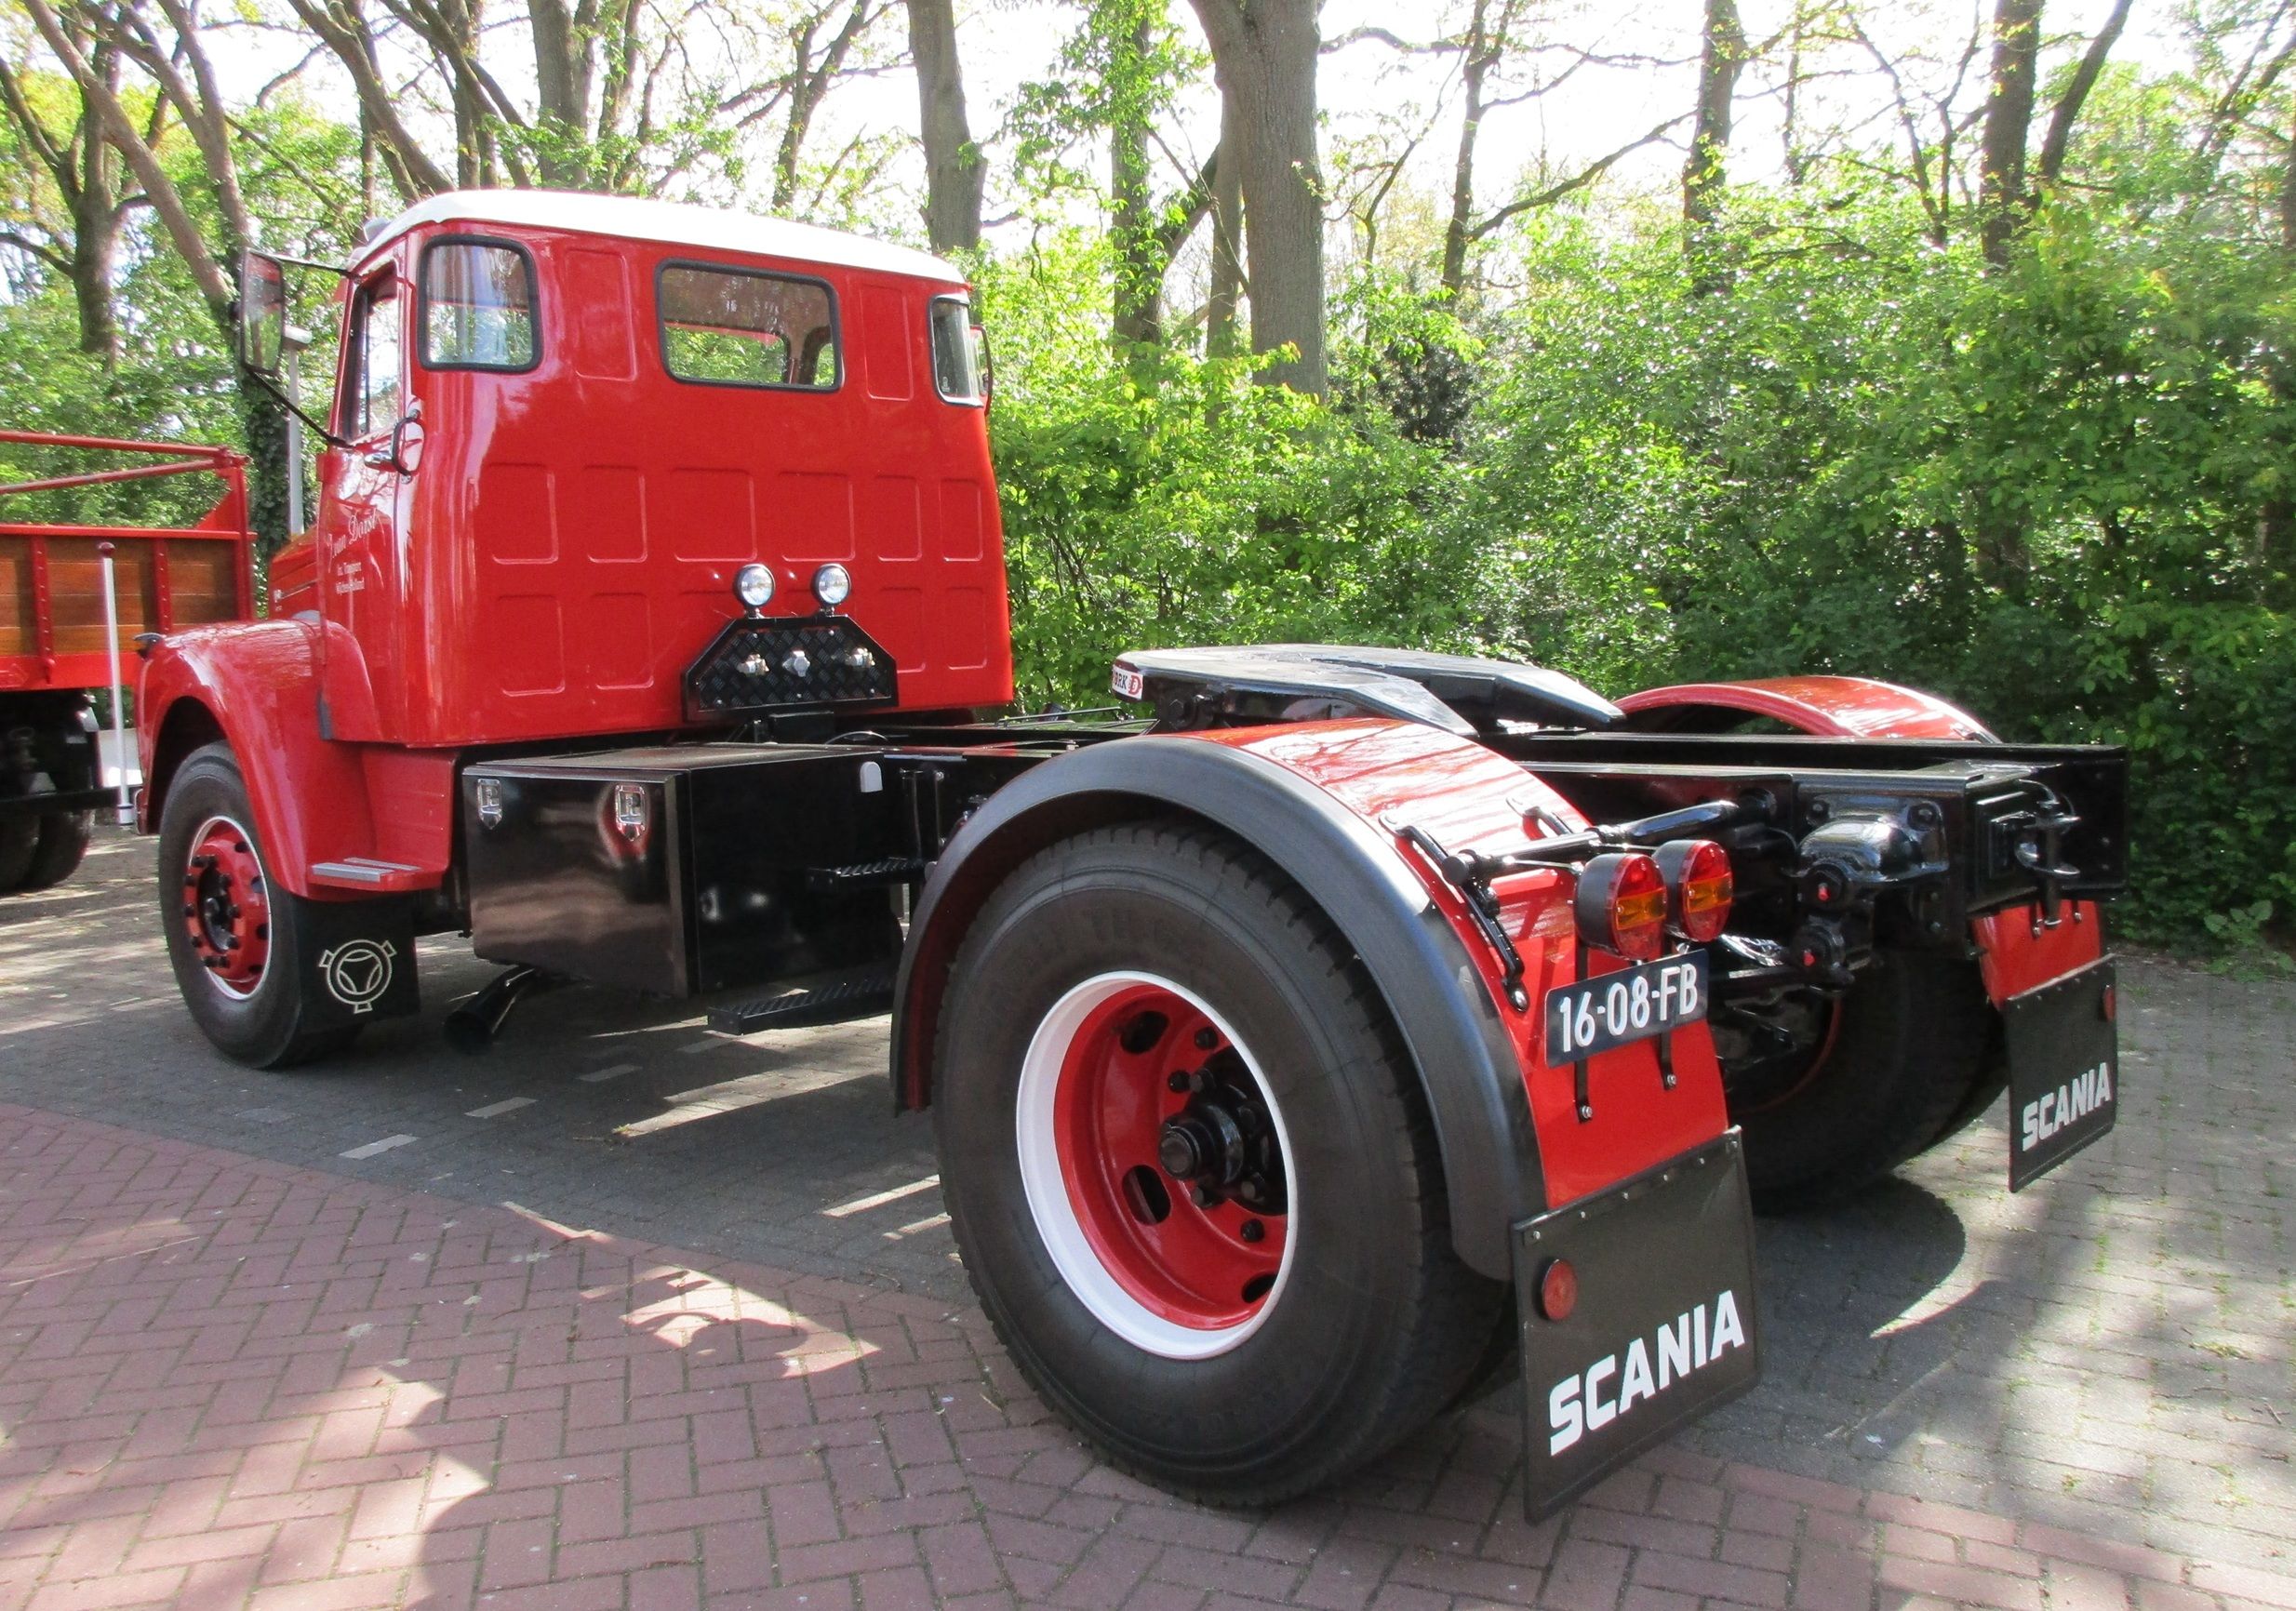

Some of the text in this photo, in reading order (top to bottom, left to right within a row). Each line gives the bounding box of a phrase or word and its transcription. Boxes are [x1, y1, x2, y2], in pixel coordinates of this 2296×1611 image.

[1559, 963, 1698, 1053] 16-08-FB
[2022, 1061, 2112, 1152] SCANIA
[1549, 1289, 1745, 1458] SCANIA
